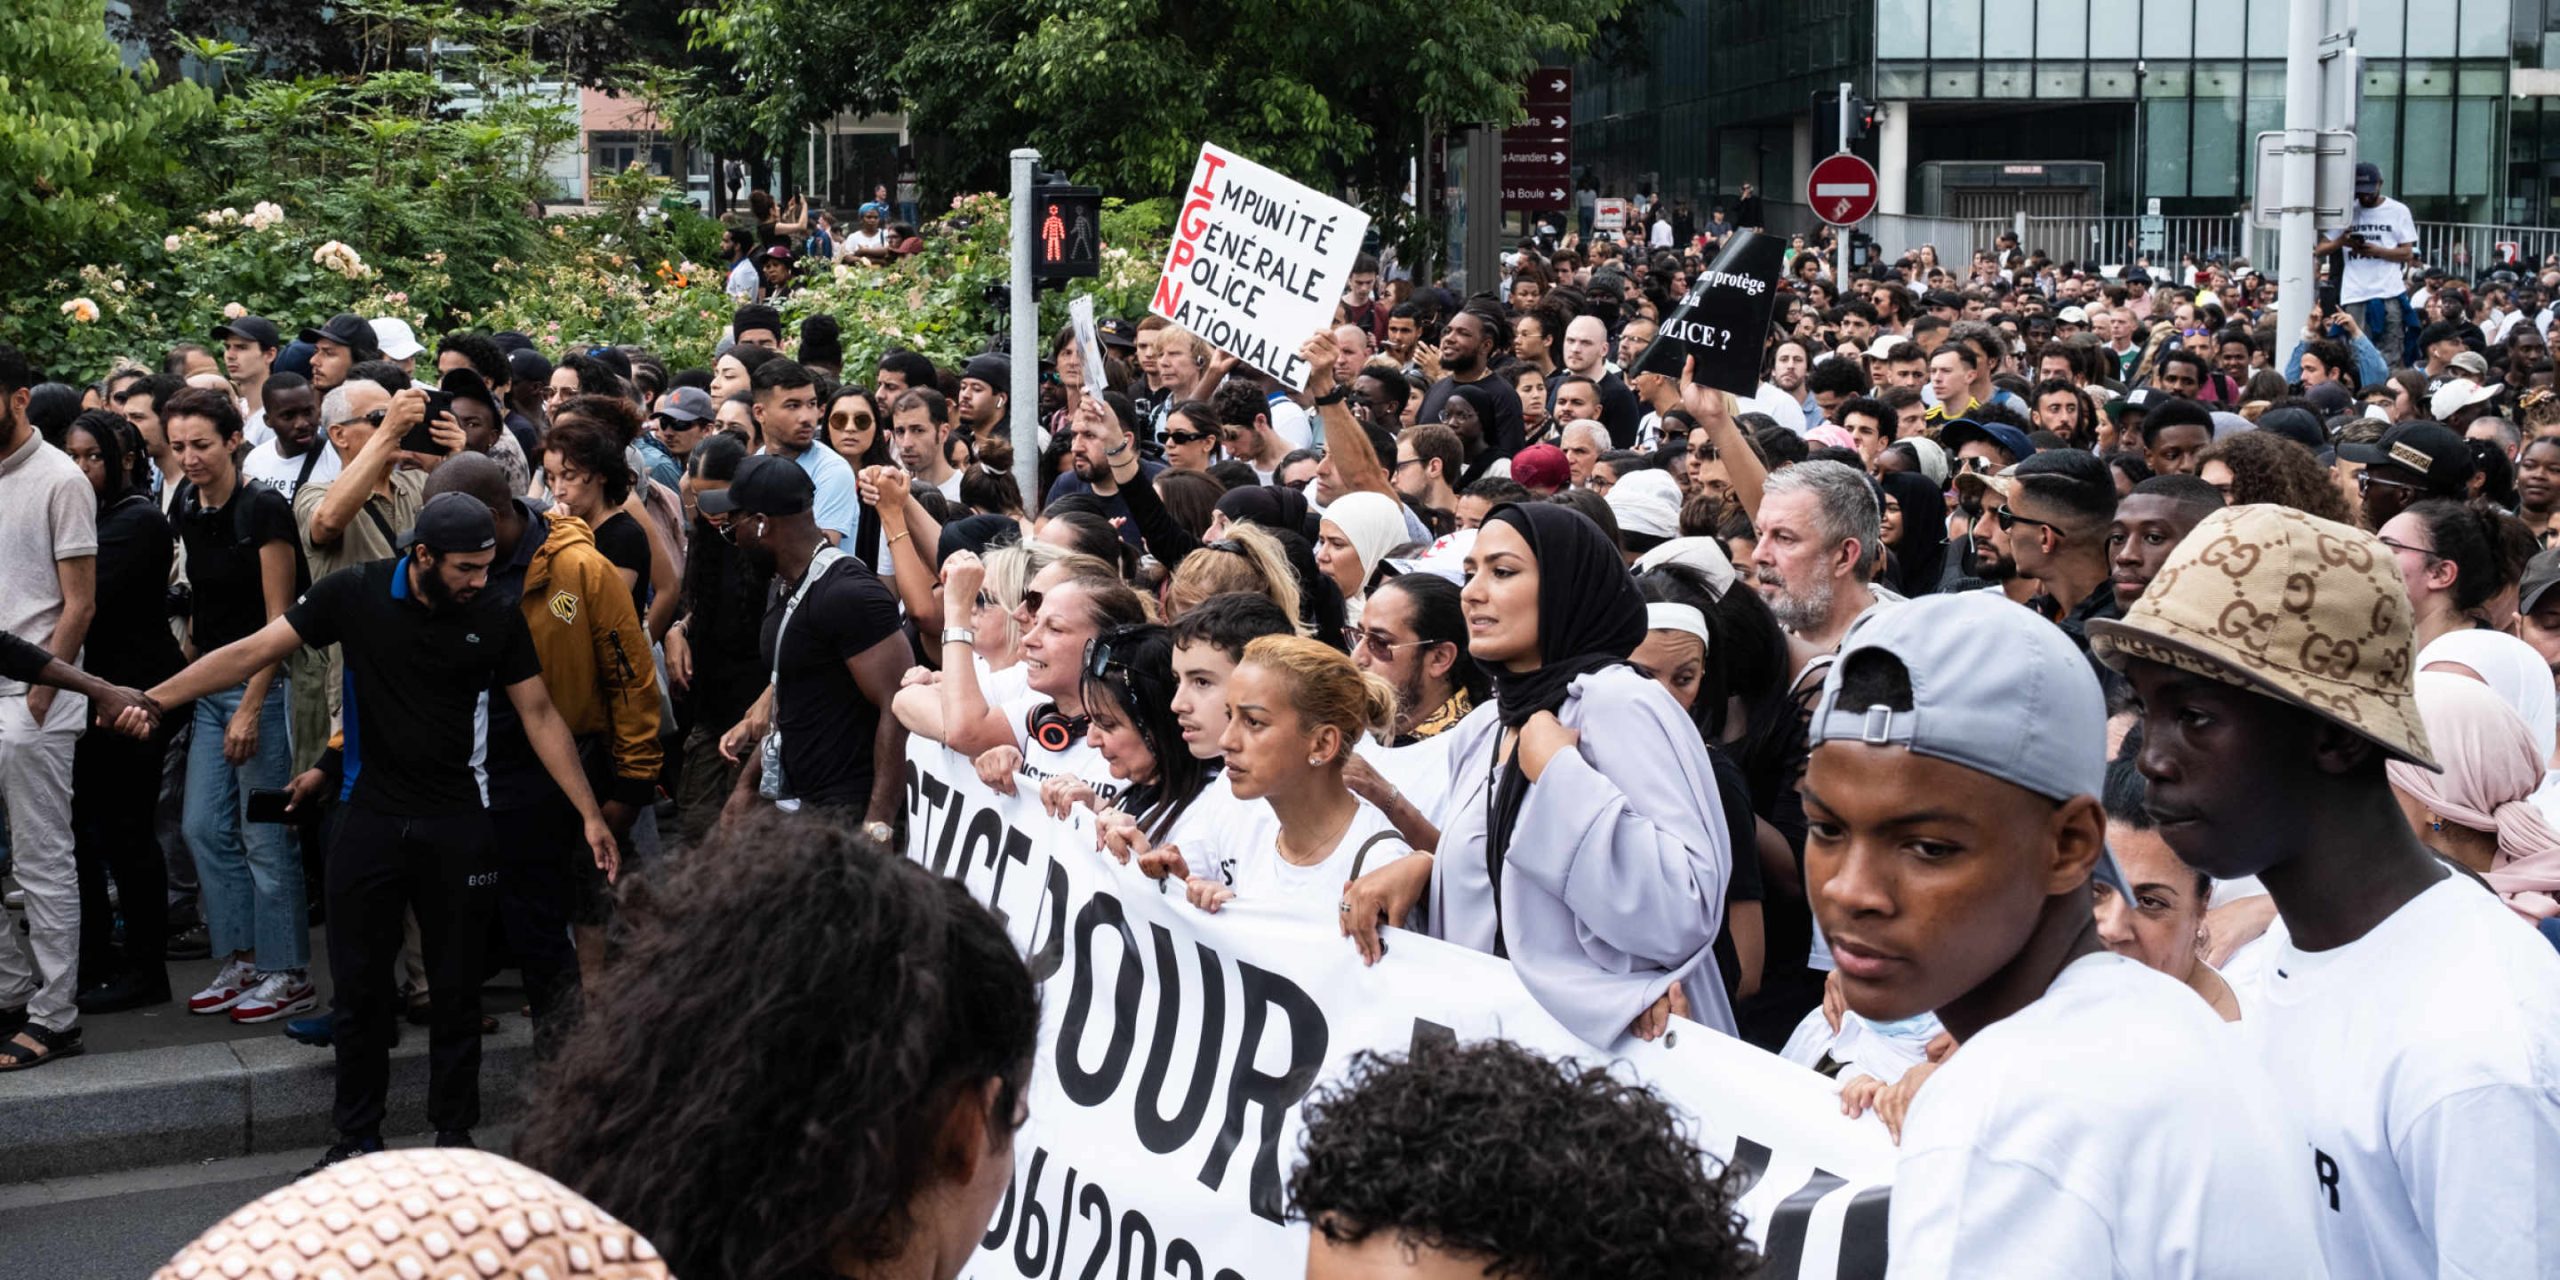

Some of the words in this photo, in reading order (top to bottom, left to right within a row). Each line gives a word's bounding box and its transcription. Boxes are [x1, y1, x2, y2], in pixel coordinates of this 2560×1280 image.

[1506, 188, 1516, 199] la
[1518, 188, 1545, 199] Boule
[2352, 224, 2393, 233] USTICE
[1181, 199, 1325, 303] GÉNÉRALE
[1712, 271, 1766, 296] protège
[1659, 317, 1716, 347] OLICE
[1720, 330, 1731, 351] ?
[1028, 855, 1329, 1227] POUR
